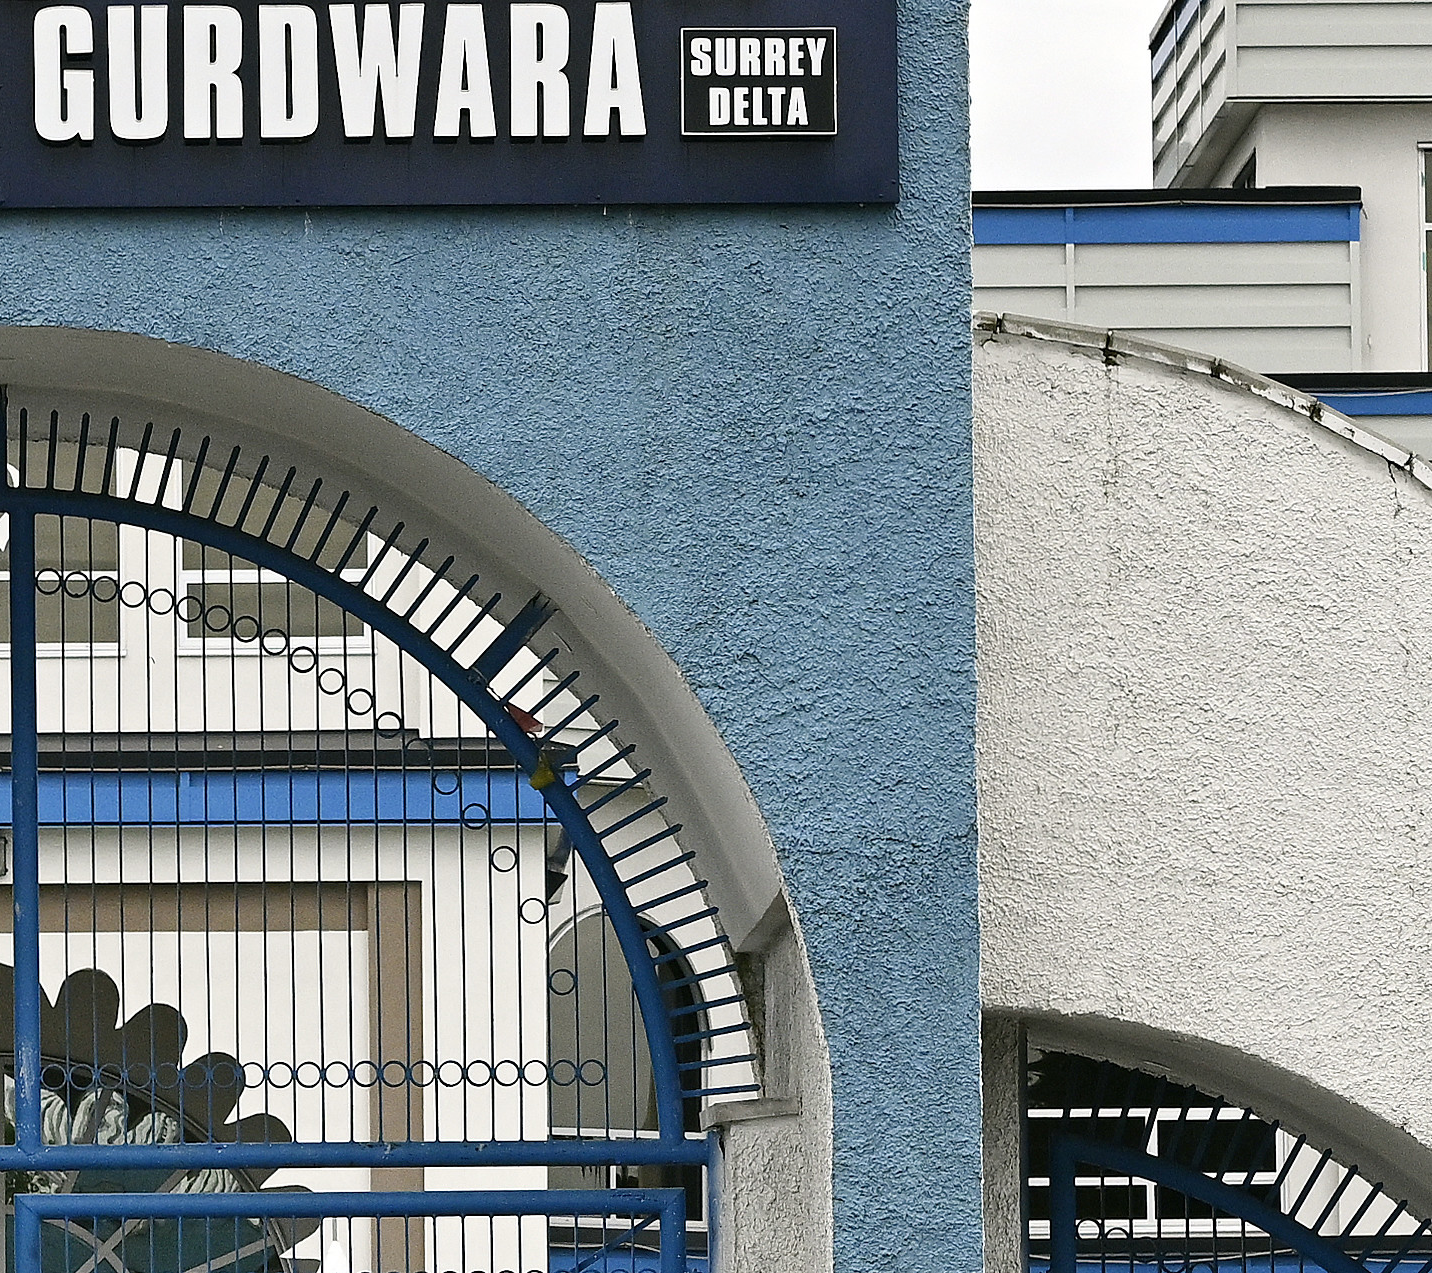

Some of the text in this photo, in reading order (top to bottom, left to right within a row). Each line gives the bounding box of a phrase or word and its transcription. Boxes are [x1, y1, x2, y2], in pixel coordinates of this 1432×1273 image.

[34, 2, 647, 141] GURDWARA
[689, 36, 827, 77] SURREY
[708, 86, 808, 127] DELTA
